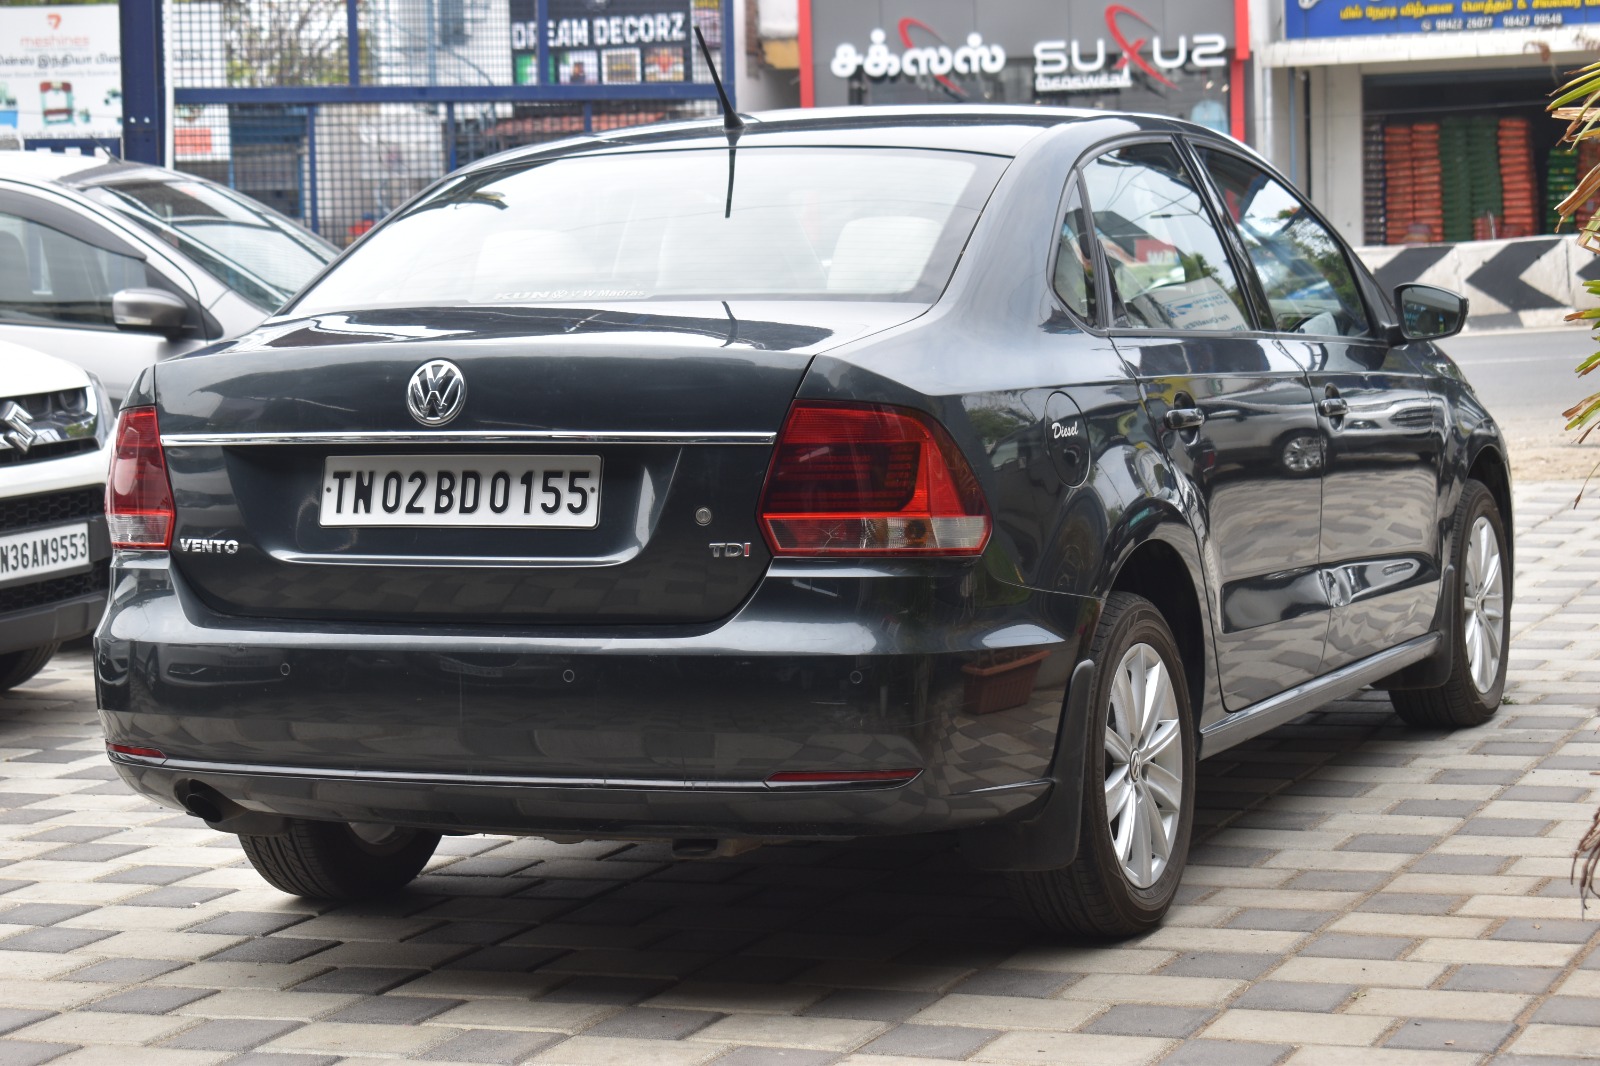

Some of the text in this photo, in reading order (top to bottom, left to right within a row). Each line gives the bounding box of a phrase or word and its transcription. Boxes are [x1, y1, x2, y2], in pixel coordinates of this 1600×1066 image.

[593, 12, 687, 46] DECORZ
[20, 34, 91, 47] meshines
[831, 28, 1006, 78] சக்ஸஸ்
[598, 288, 645, 298] Madras
[1051, 420, 1079, 439] Diesel
[332, 470, 591, 515] TN02BD0155
[0, 532, 87, 573] N36AM9553
[179, 538, 239, 554] VENTO
[708, 542, 751, 558] TDI
